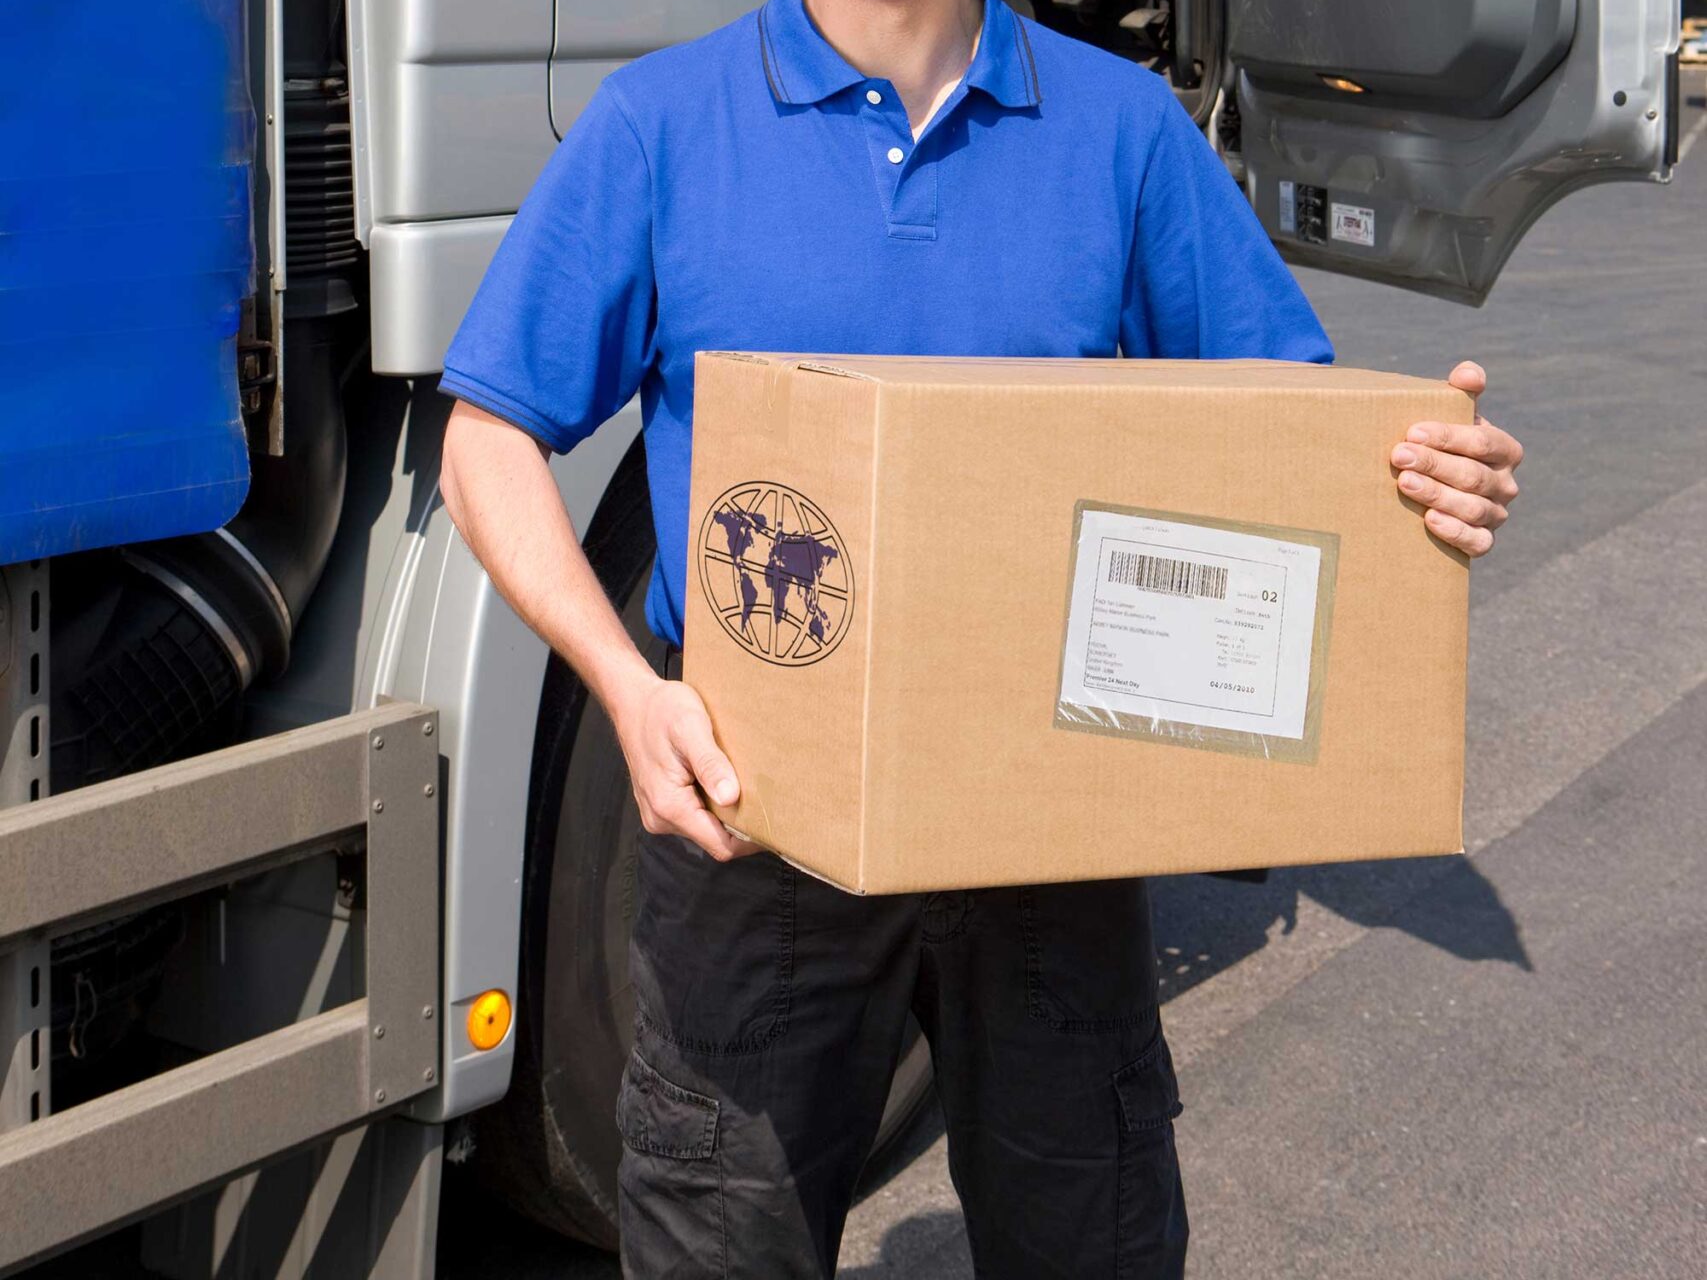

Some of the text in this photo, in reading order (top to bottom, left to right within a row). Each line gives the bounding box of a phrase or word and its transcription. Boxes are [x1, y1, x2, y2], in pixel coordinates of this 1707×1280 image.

[1261, 589, 1279, 603] 02
[1116, 678, 1128, 686] Next
[1129, 679, 1140, 689] Day
